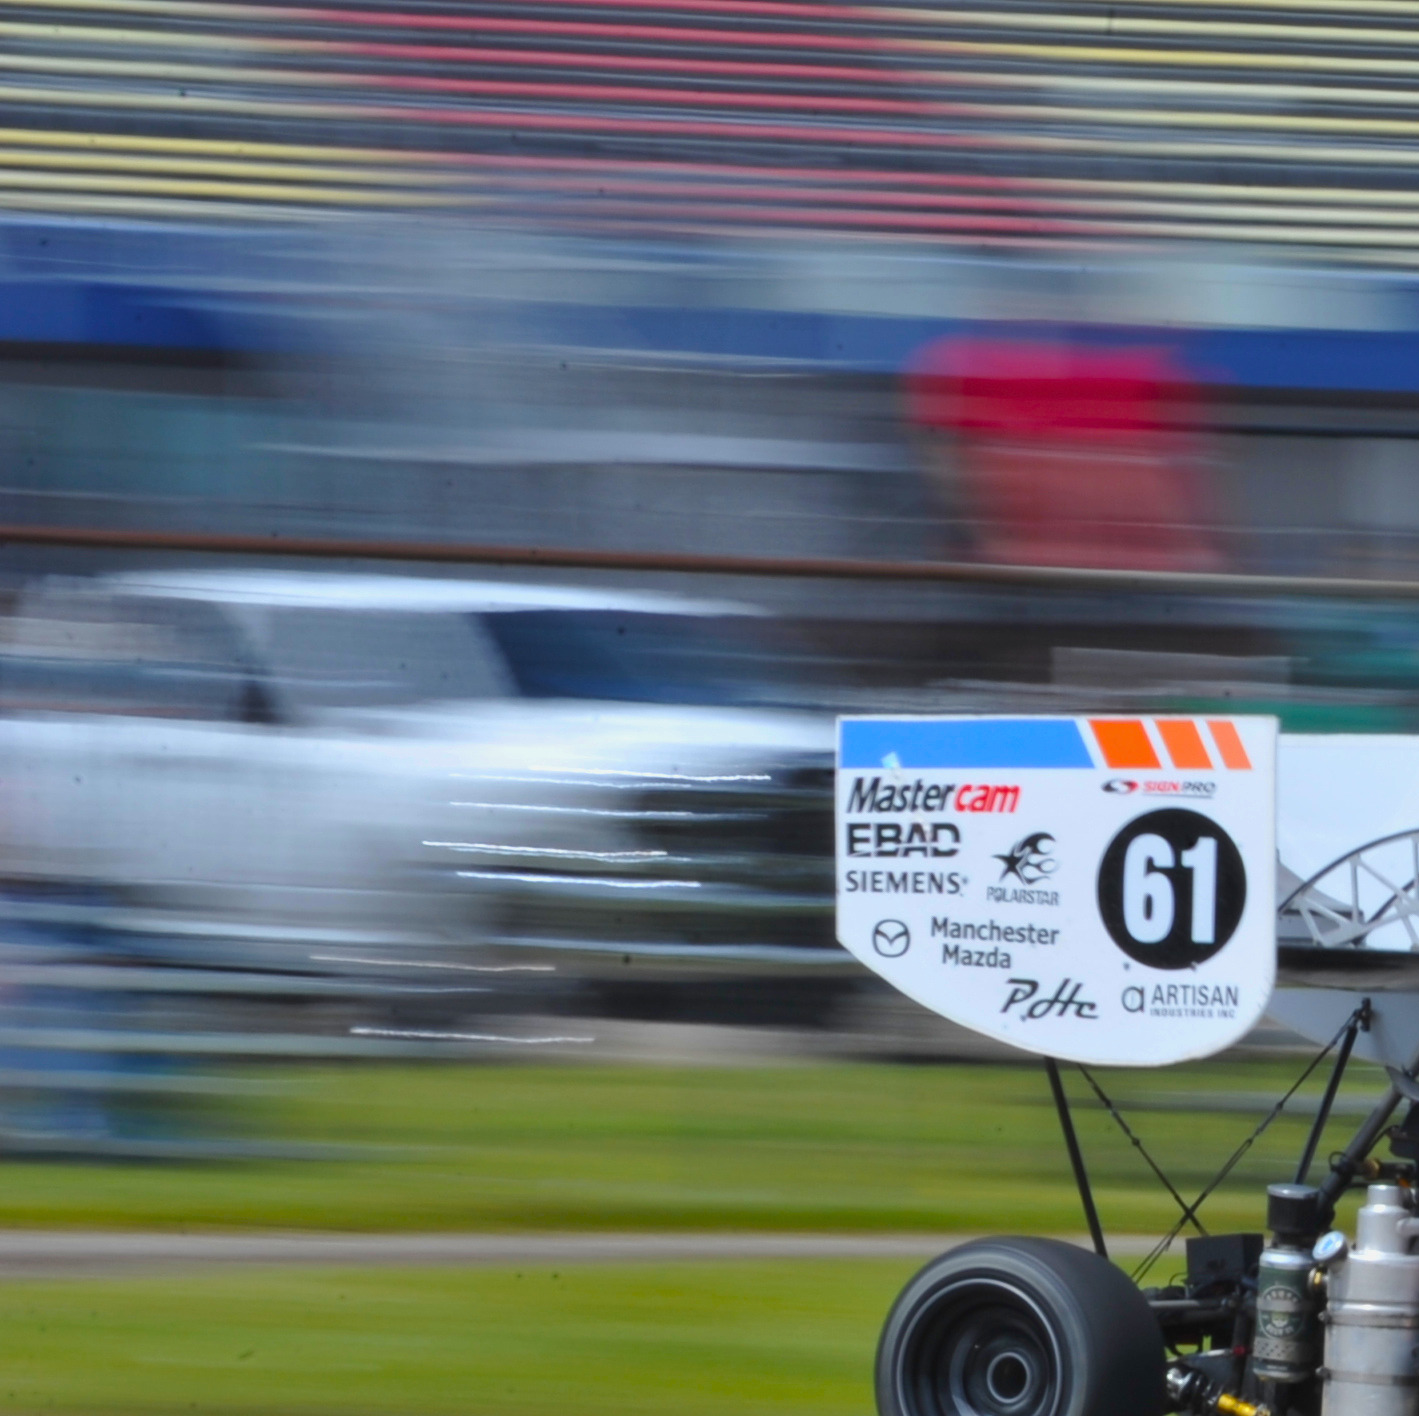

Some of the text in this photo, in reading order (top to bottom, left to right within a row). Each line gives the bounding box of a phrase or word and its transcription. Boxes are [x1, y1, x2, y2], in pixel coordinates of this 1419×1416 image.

[847, 777, 1021, 813] Mastercam
[846, 822, 961, 857] EBAD
[845, 870, 961, 895] SIEMENS
[986, 885, 1060, 907] POLARSTAR
[1123, 832, 1217, 944] 61
[930, 916, 1060, 946] Manchester
[942, 944, 1012, 969] Mazda
[1150, 984, 1239, 1008] ARTISAN
